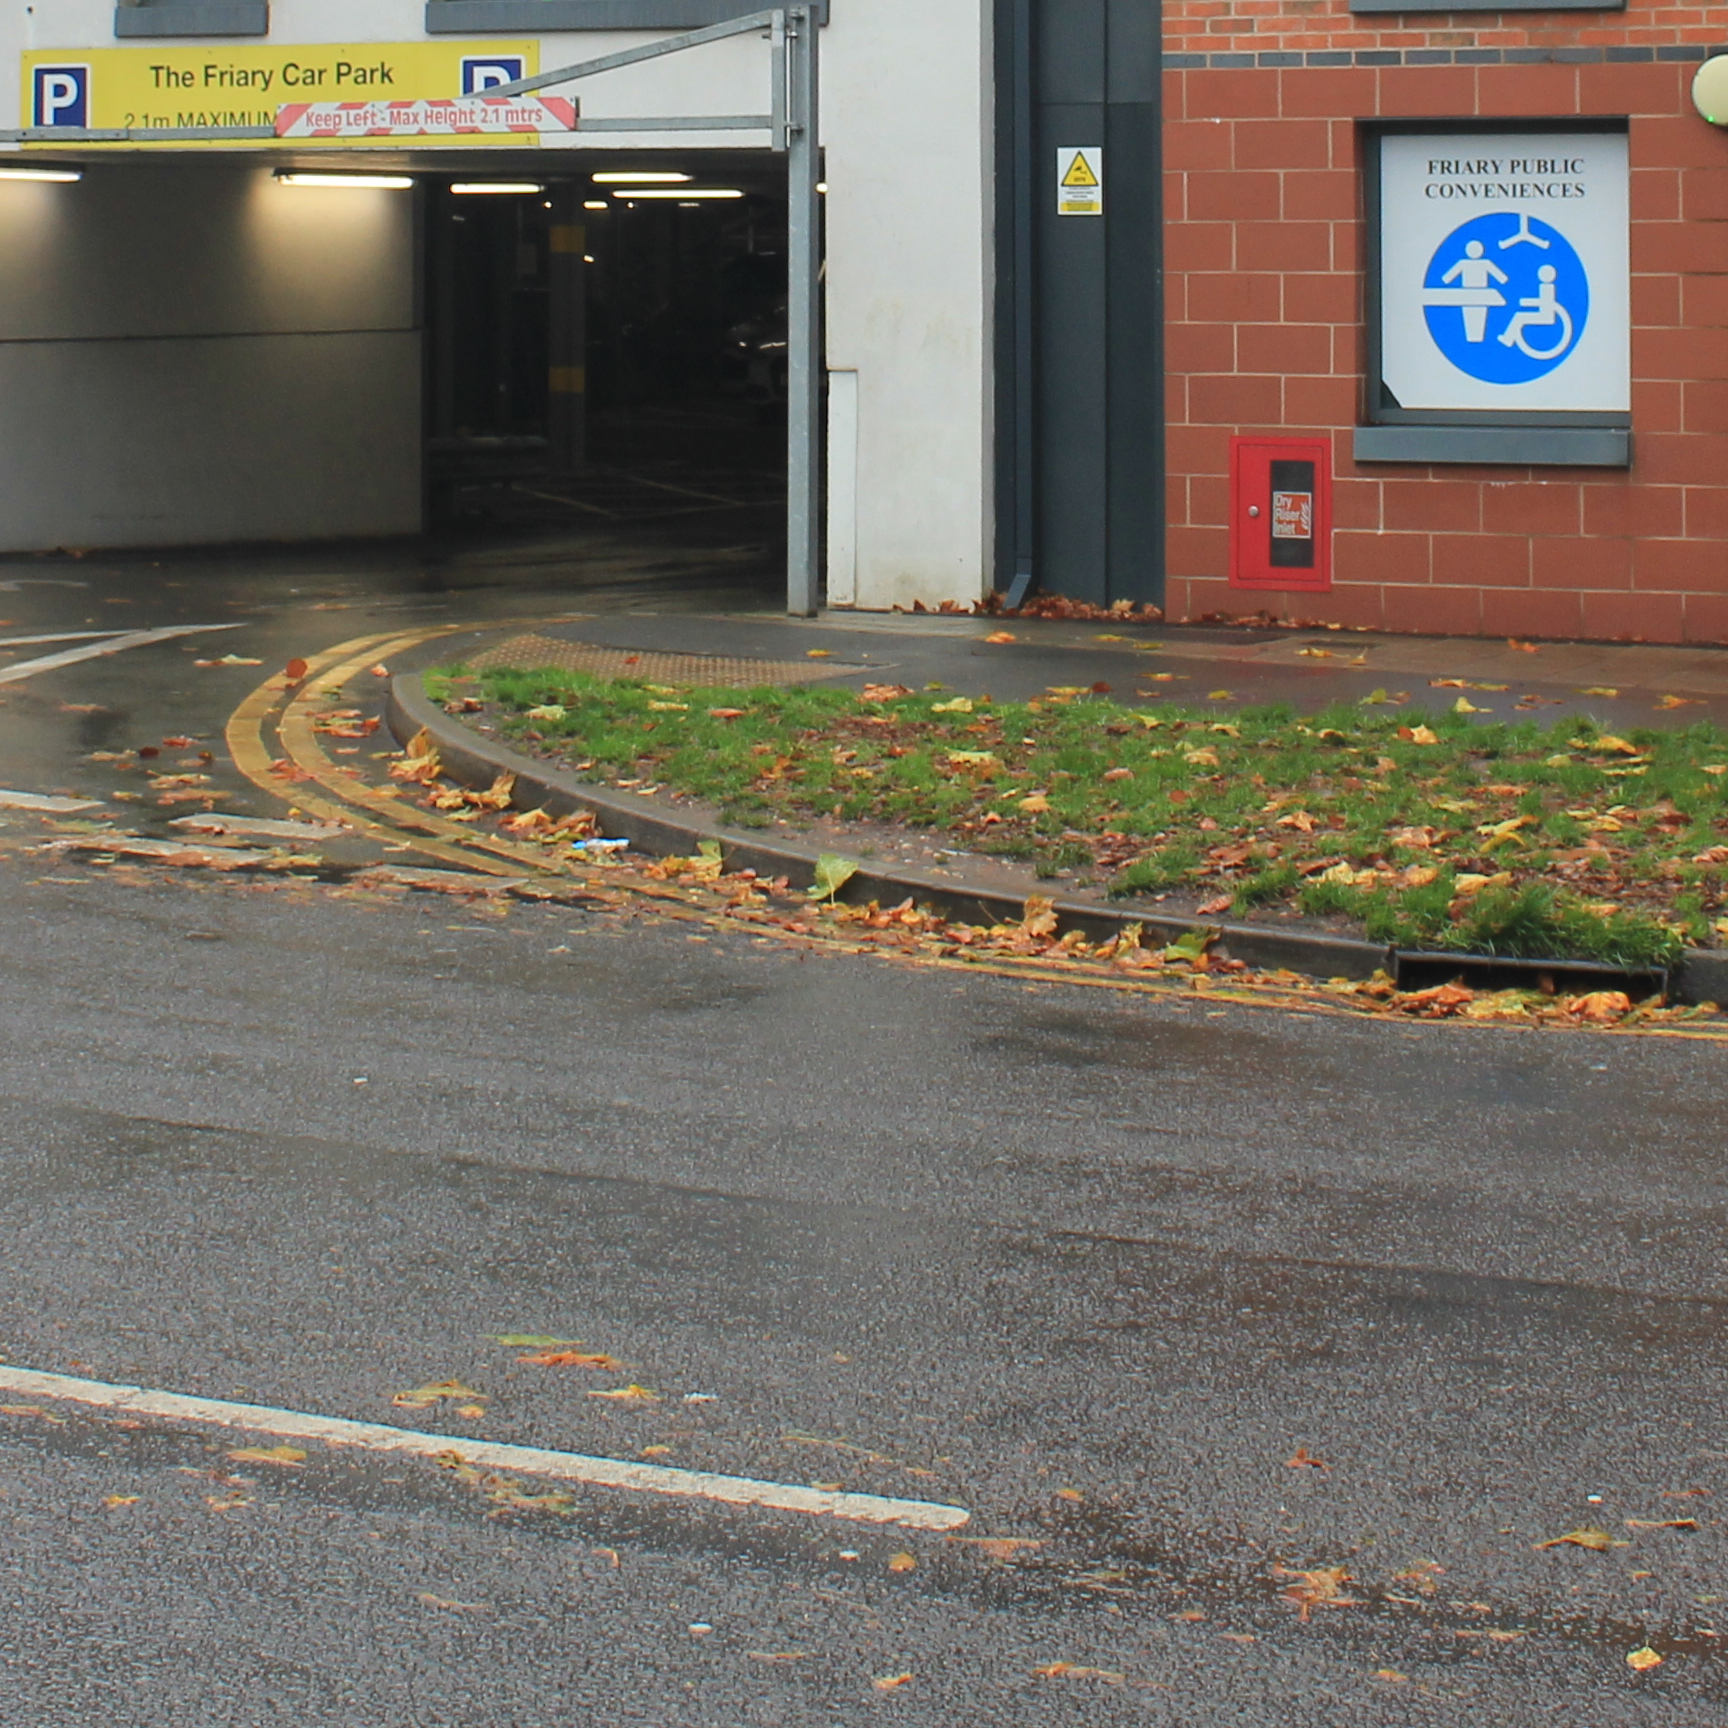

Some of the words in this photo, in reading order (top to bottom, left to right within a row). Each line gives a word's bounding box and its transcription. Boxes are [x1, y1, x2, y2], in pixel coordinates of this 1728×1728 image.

[150, 65, 194, 88] The
[203, 64, 274, 91] Friary
[282, 62, 327, 86] Car
[335, 62, 395, 85] Park
[42, 73, 79, 125] P
[124, 112, 170, 129] 21m
[176, 111, 278, 128] MAXIMUM
[305, 111, 341, 129] Keep
[346, 110, 377, 127] Left
[389, 109, 420, 125] Max
[424, 108, 475, 126] Height
[480, 108, 501, 123] 2.1
[505, 107, 543, 123] mtrs
[1427, 159, 1503, 175] FRIARY
[1509, 158, 1585, 174] PUBLIC
[1425, 183, 1585, 199] CONVENIENCES
